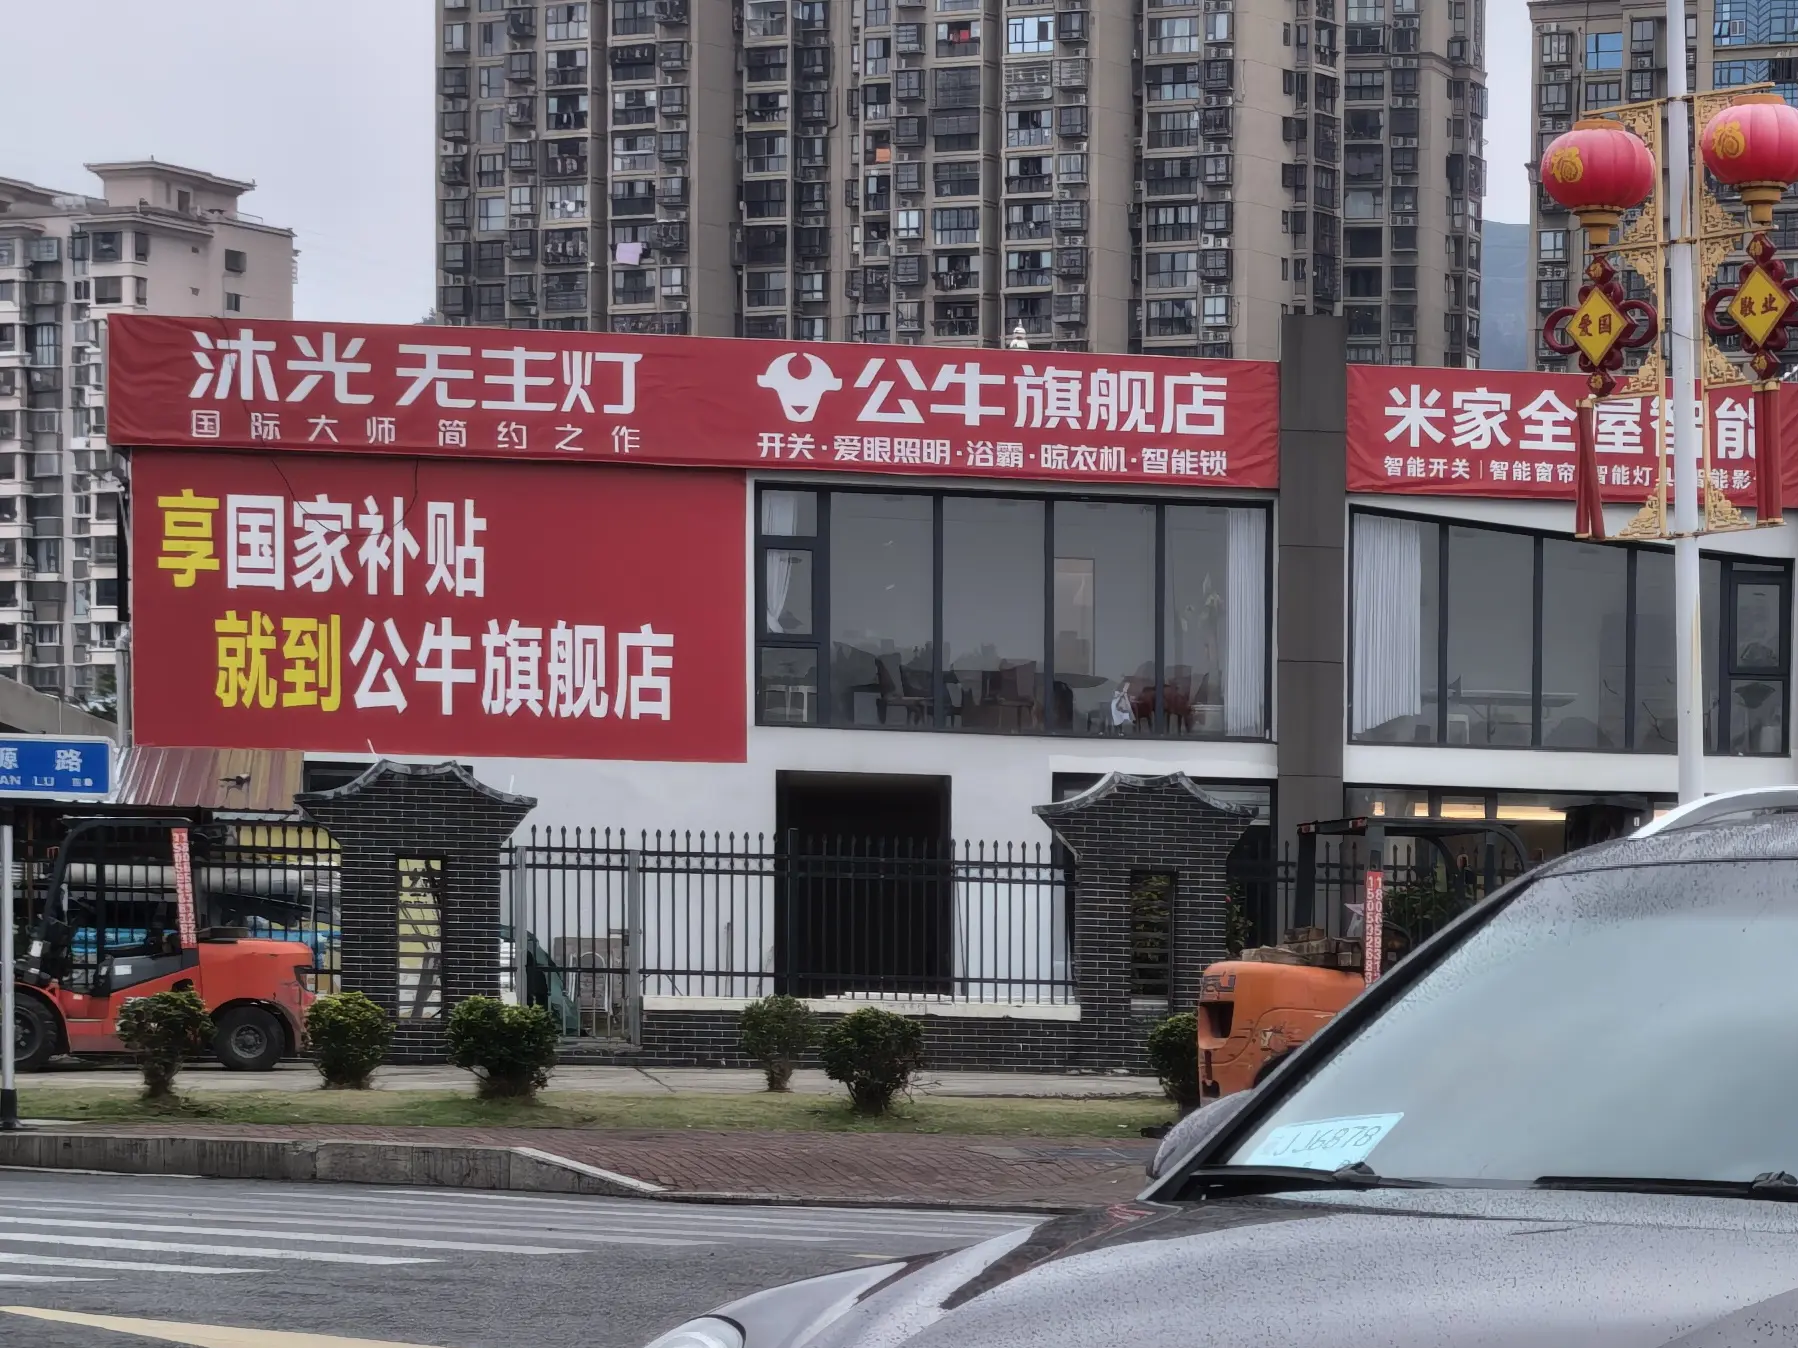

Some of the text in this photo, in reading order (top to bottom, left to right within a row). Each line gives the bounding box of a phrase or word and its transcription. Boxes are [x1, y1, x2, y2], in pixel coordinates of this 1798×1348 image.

[189, 330, 643, 414] 沐光 无主灯
[853, 357, 1228, 436] 公牛旗舰店
[191, 410, 640, 453] 国际大师 简约之作
[1384, 456, 1470, 480] 智能开关
[1490, 461, 1575, 484] 智能窗帘
[157, 489, 487, 598] 享国家补贴
[215, 610, 674, 721] 就到公牛旗舰店
[34, 776, 55, 787] LU
